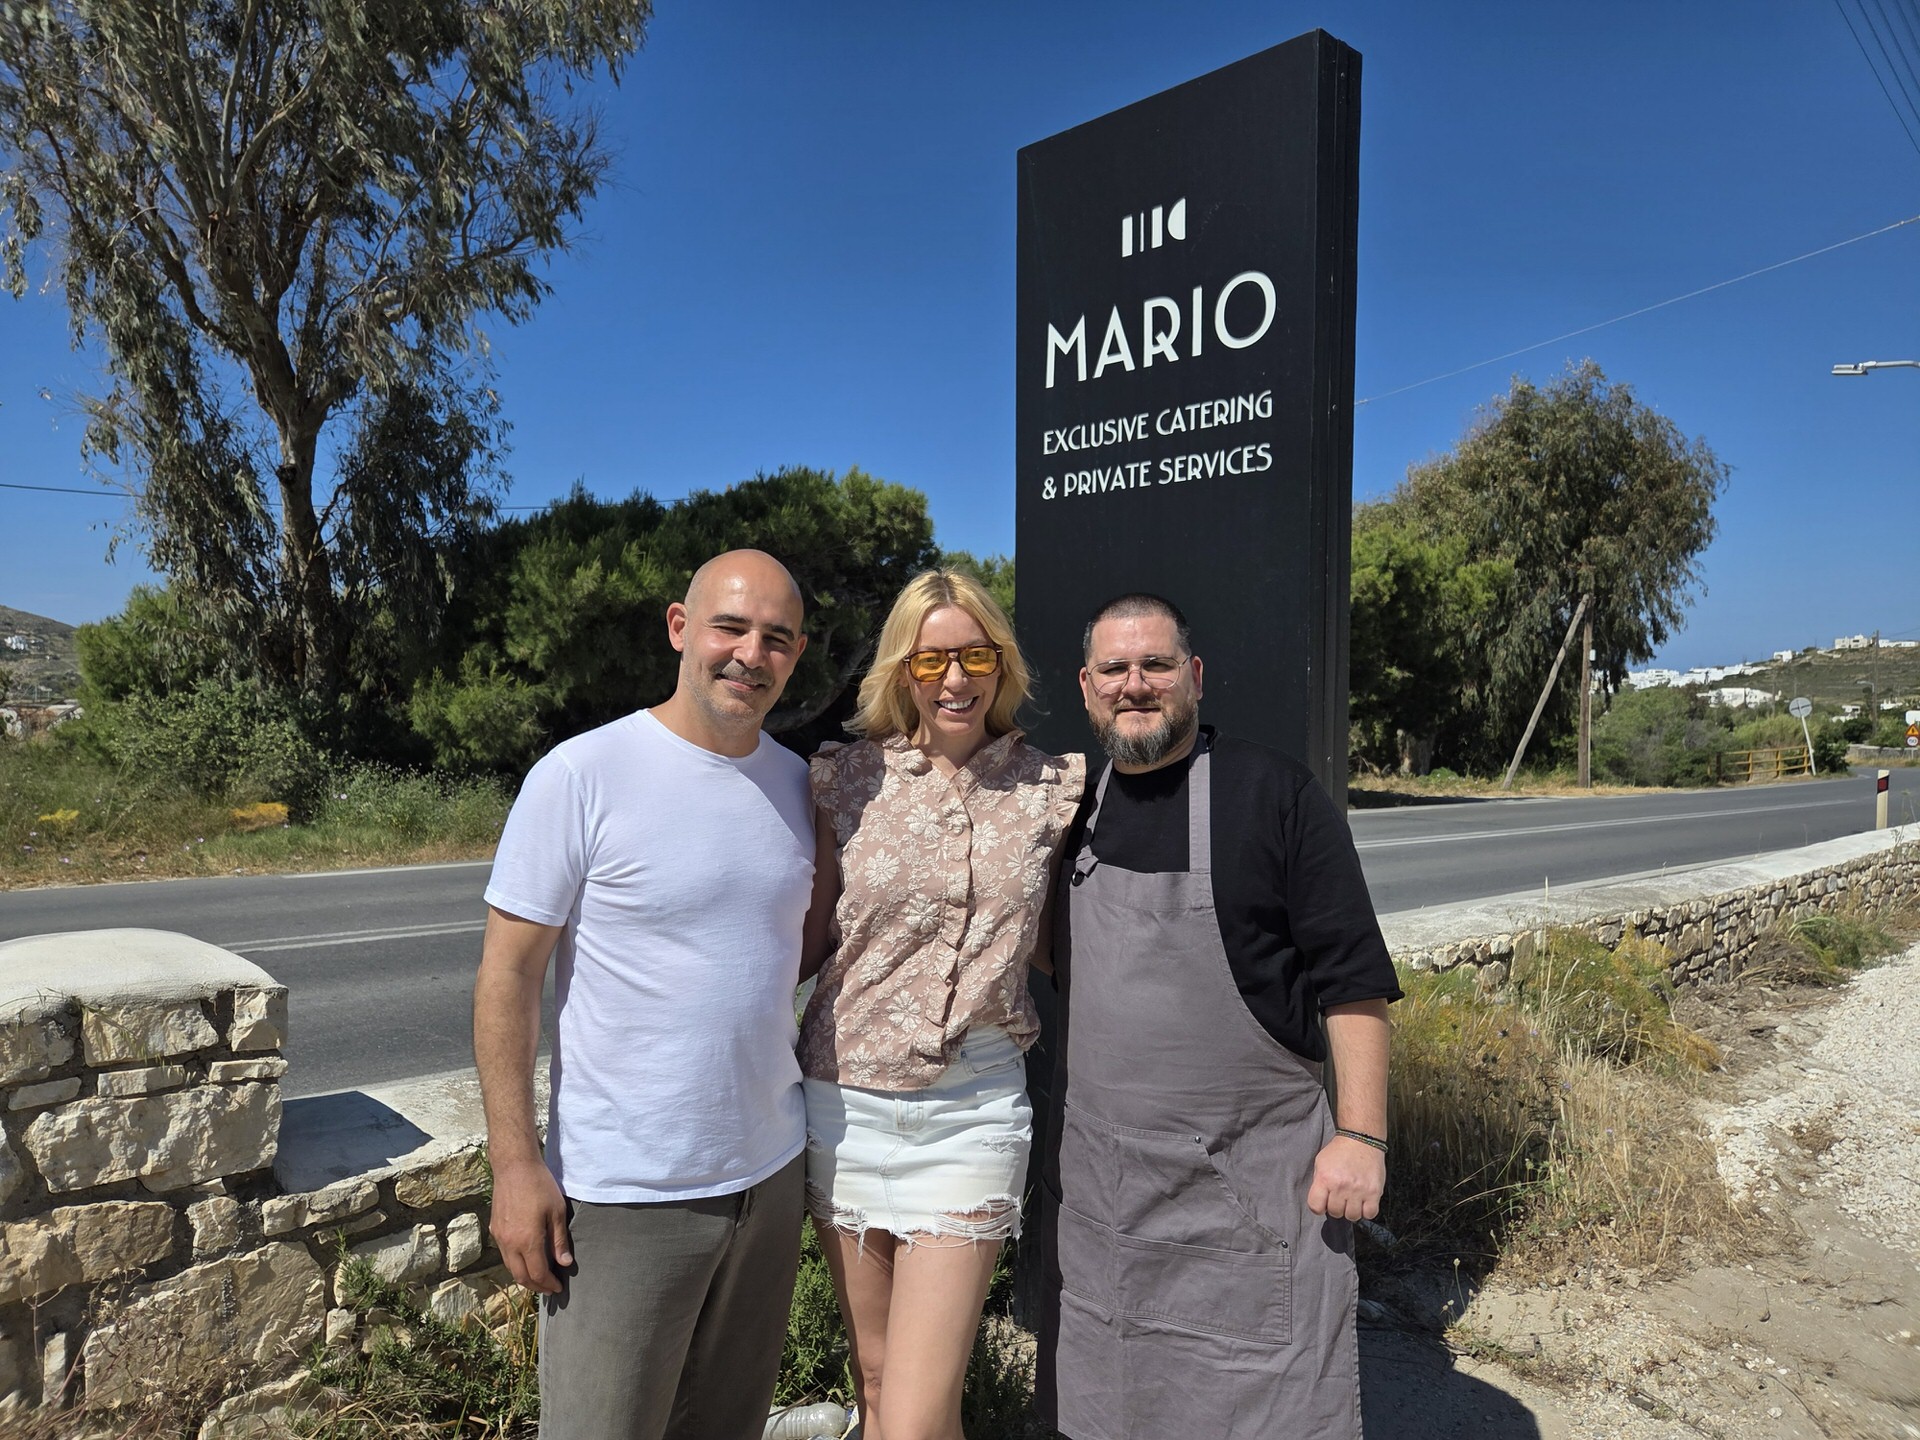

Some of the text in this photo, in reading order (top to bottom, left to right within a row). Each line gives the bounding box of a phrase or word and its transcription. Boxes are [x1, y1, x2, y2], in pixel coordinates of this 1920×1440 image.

[1045, 271, 1277, 389] MARIO
[1043, 389, 1273, 455] EXCLUSIVE CATERING
[1042, 443, 1273, 500] & PRIVATE SERVICES
